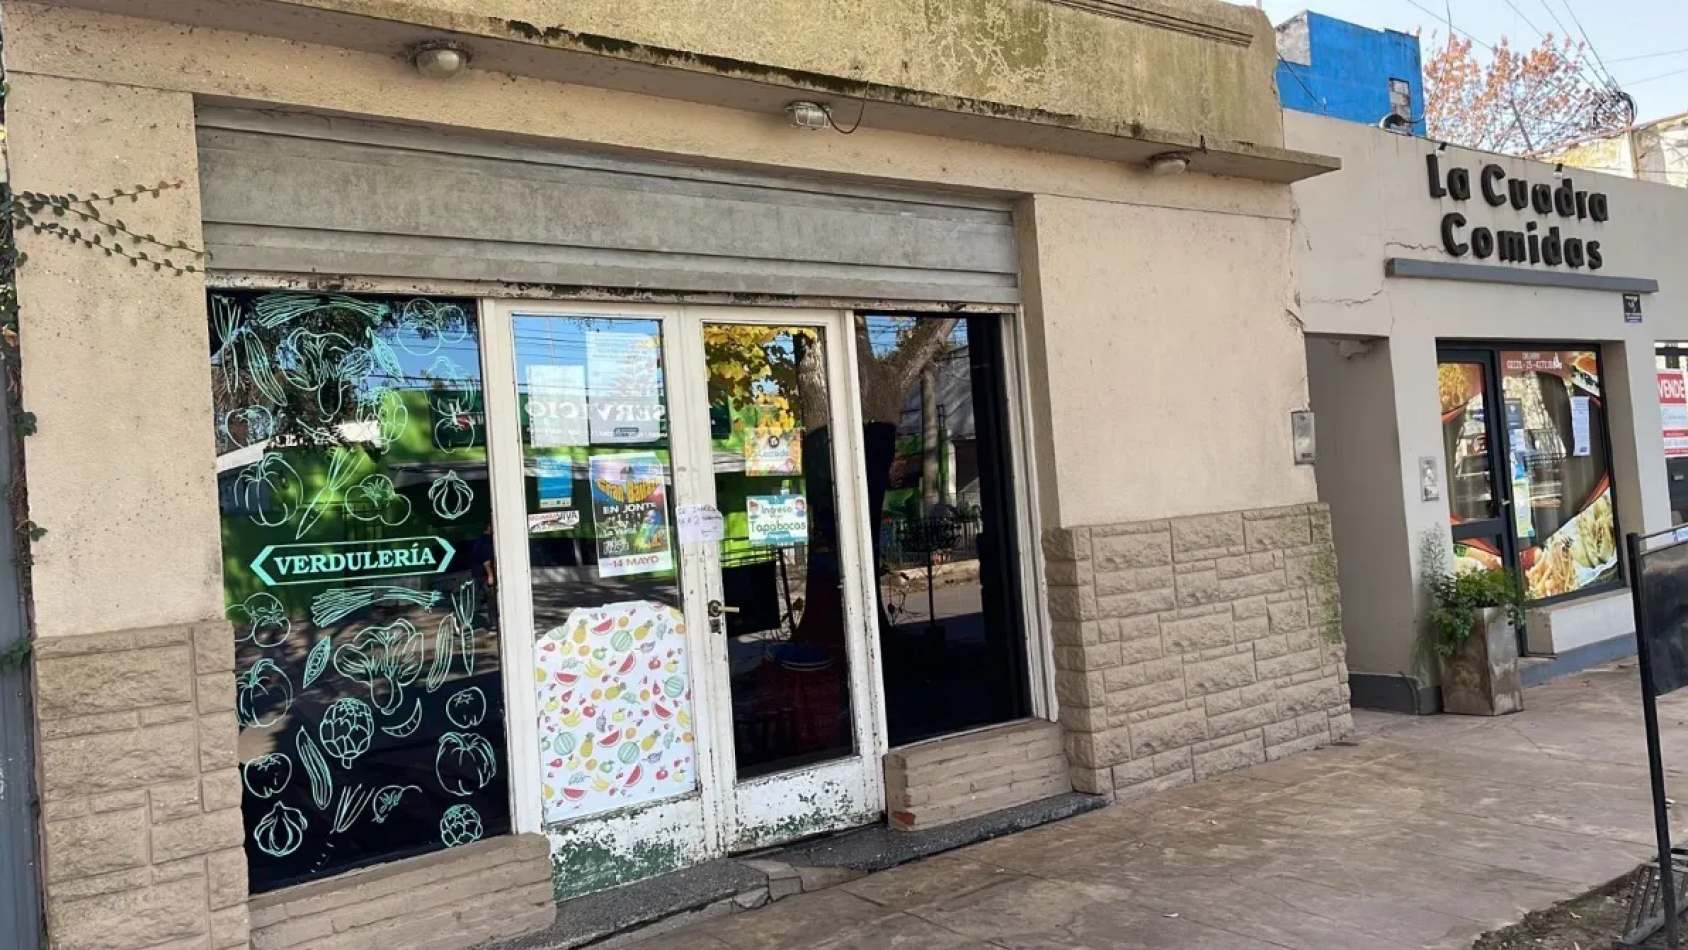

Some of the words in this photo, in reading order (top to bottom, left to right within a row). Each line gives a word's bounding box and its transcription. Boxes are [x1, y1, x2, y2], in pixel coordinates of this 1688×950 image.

[1426, 153, 1471, 201] La
[1481, 163, 1609, 222] Cuadra
[1441, 212, 1603, 270] Comidas
[761, 505, 792, 515] Ingreso
[749, 519, 806, 535] Tapabocas
[273, 542, 437, 576] VERDULERÍA
[626, 555, 659, 567] MAYO
